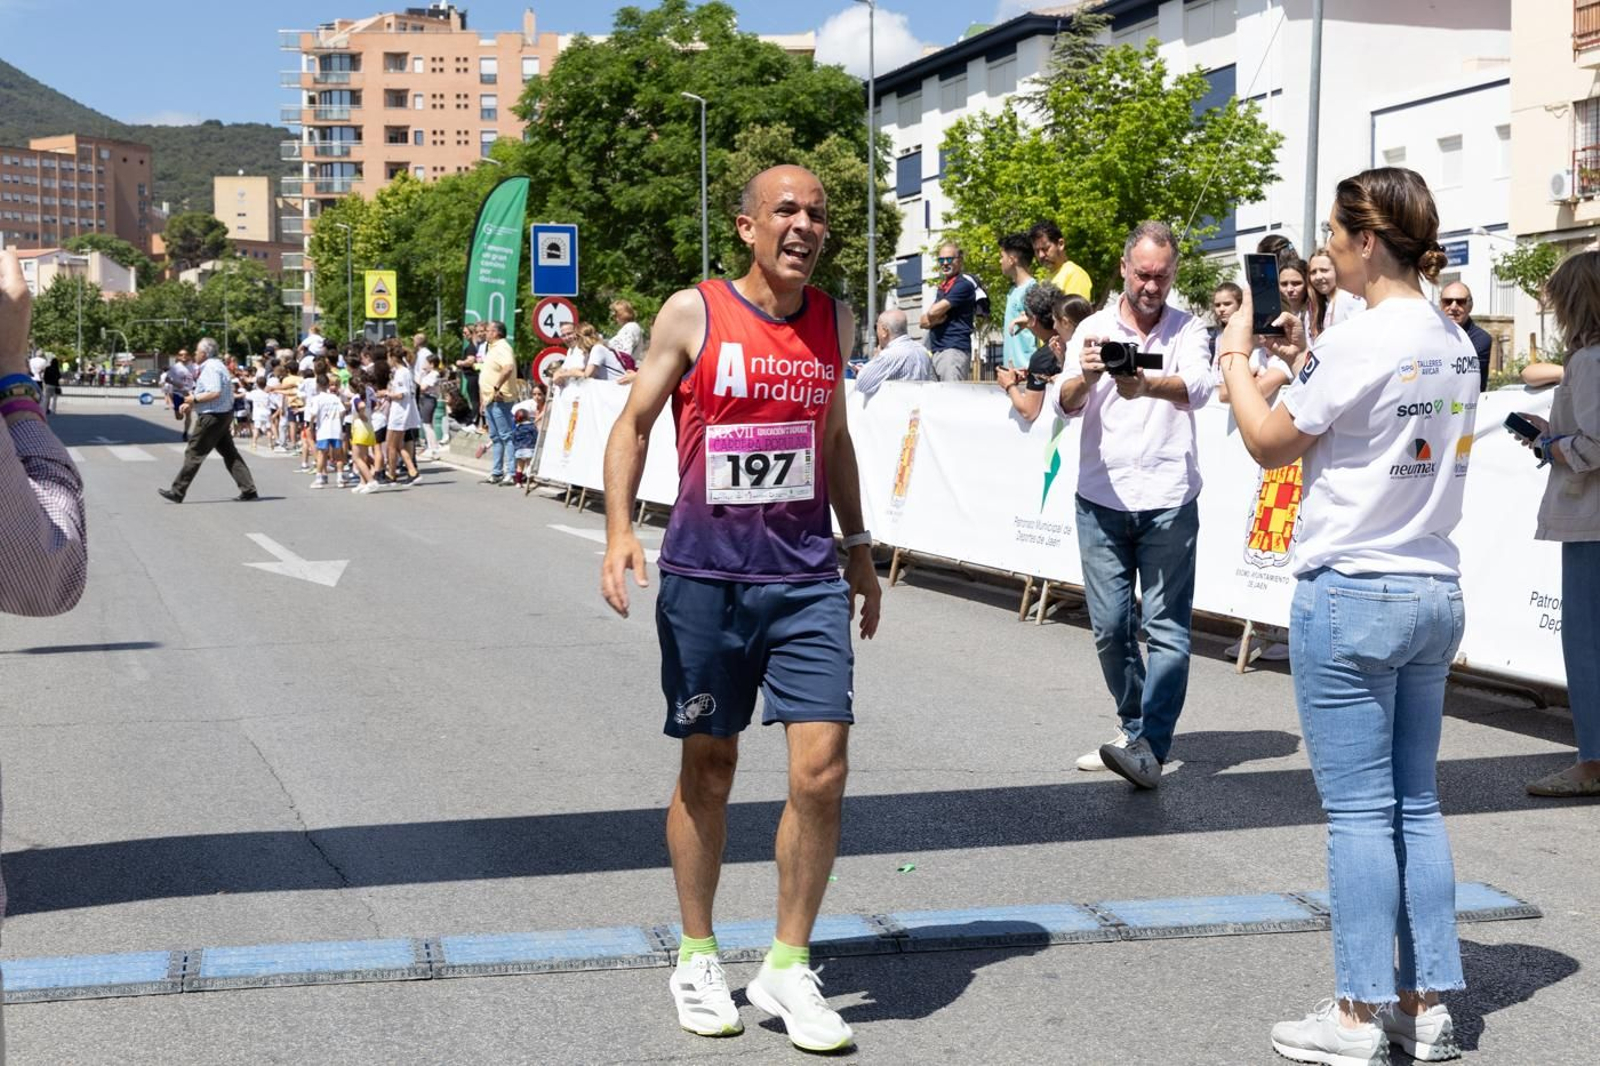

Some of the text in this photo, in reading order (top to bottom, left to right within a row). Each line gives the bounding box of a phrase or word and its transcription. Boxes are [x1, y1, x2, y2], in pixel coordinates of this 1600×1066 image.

[543, 313, 554, 328] 4
[1416, 359, 1443, 369] TALLERES
[1397, 401, 1433, 417] sano
[727, 453, 796, 487] 197
[1389, 462, 1435, 475] neumax
